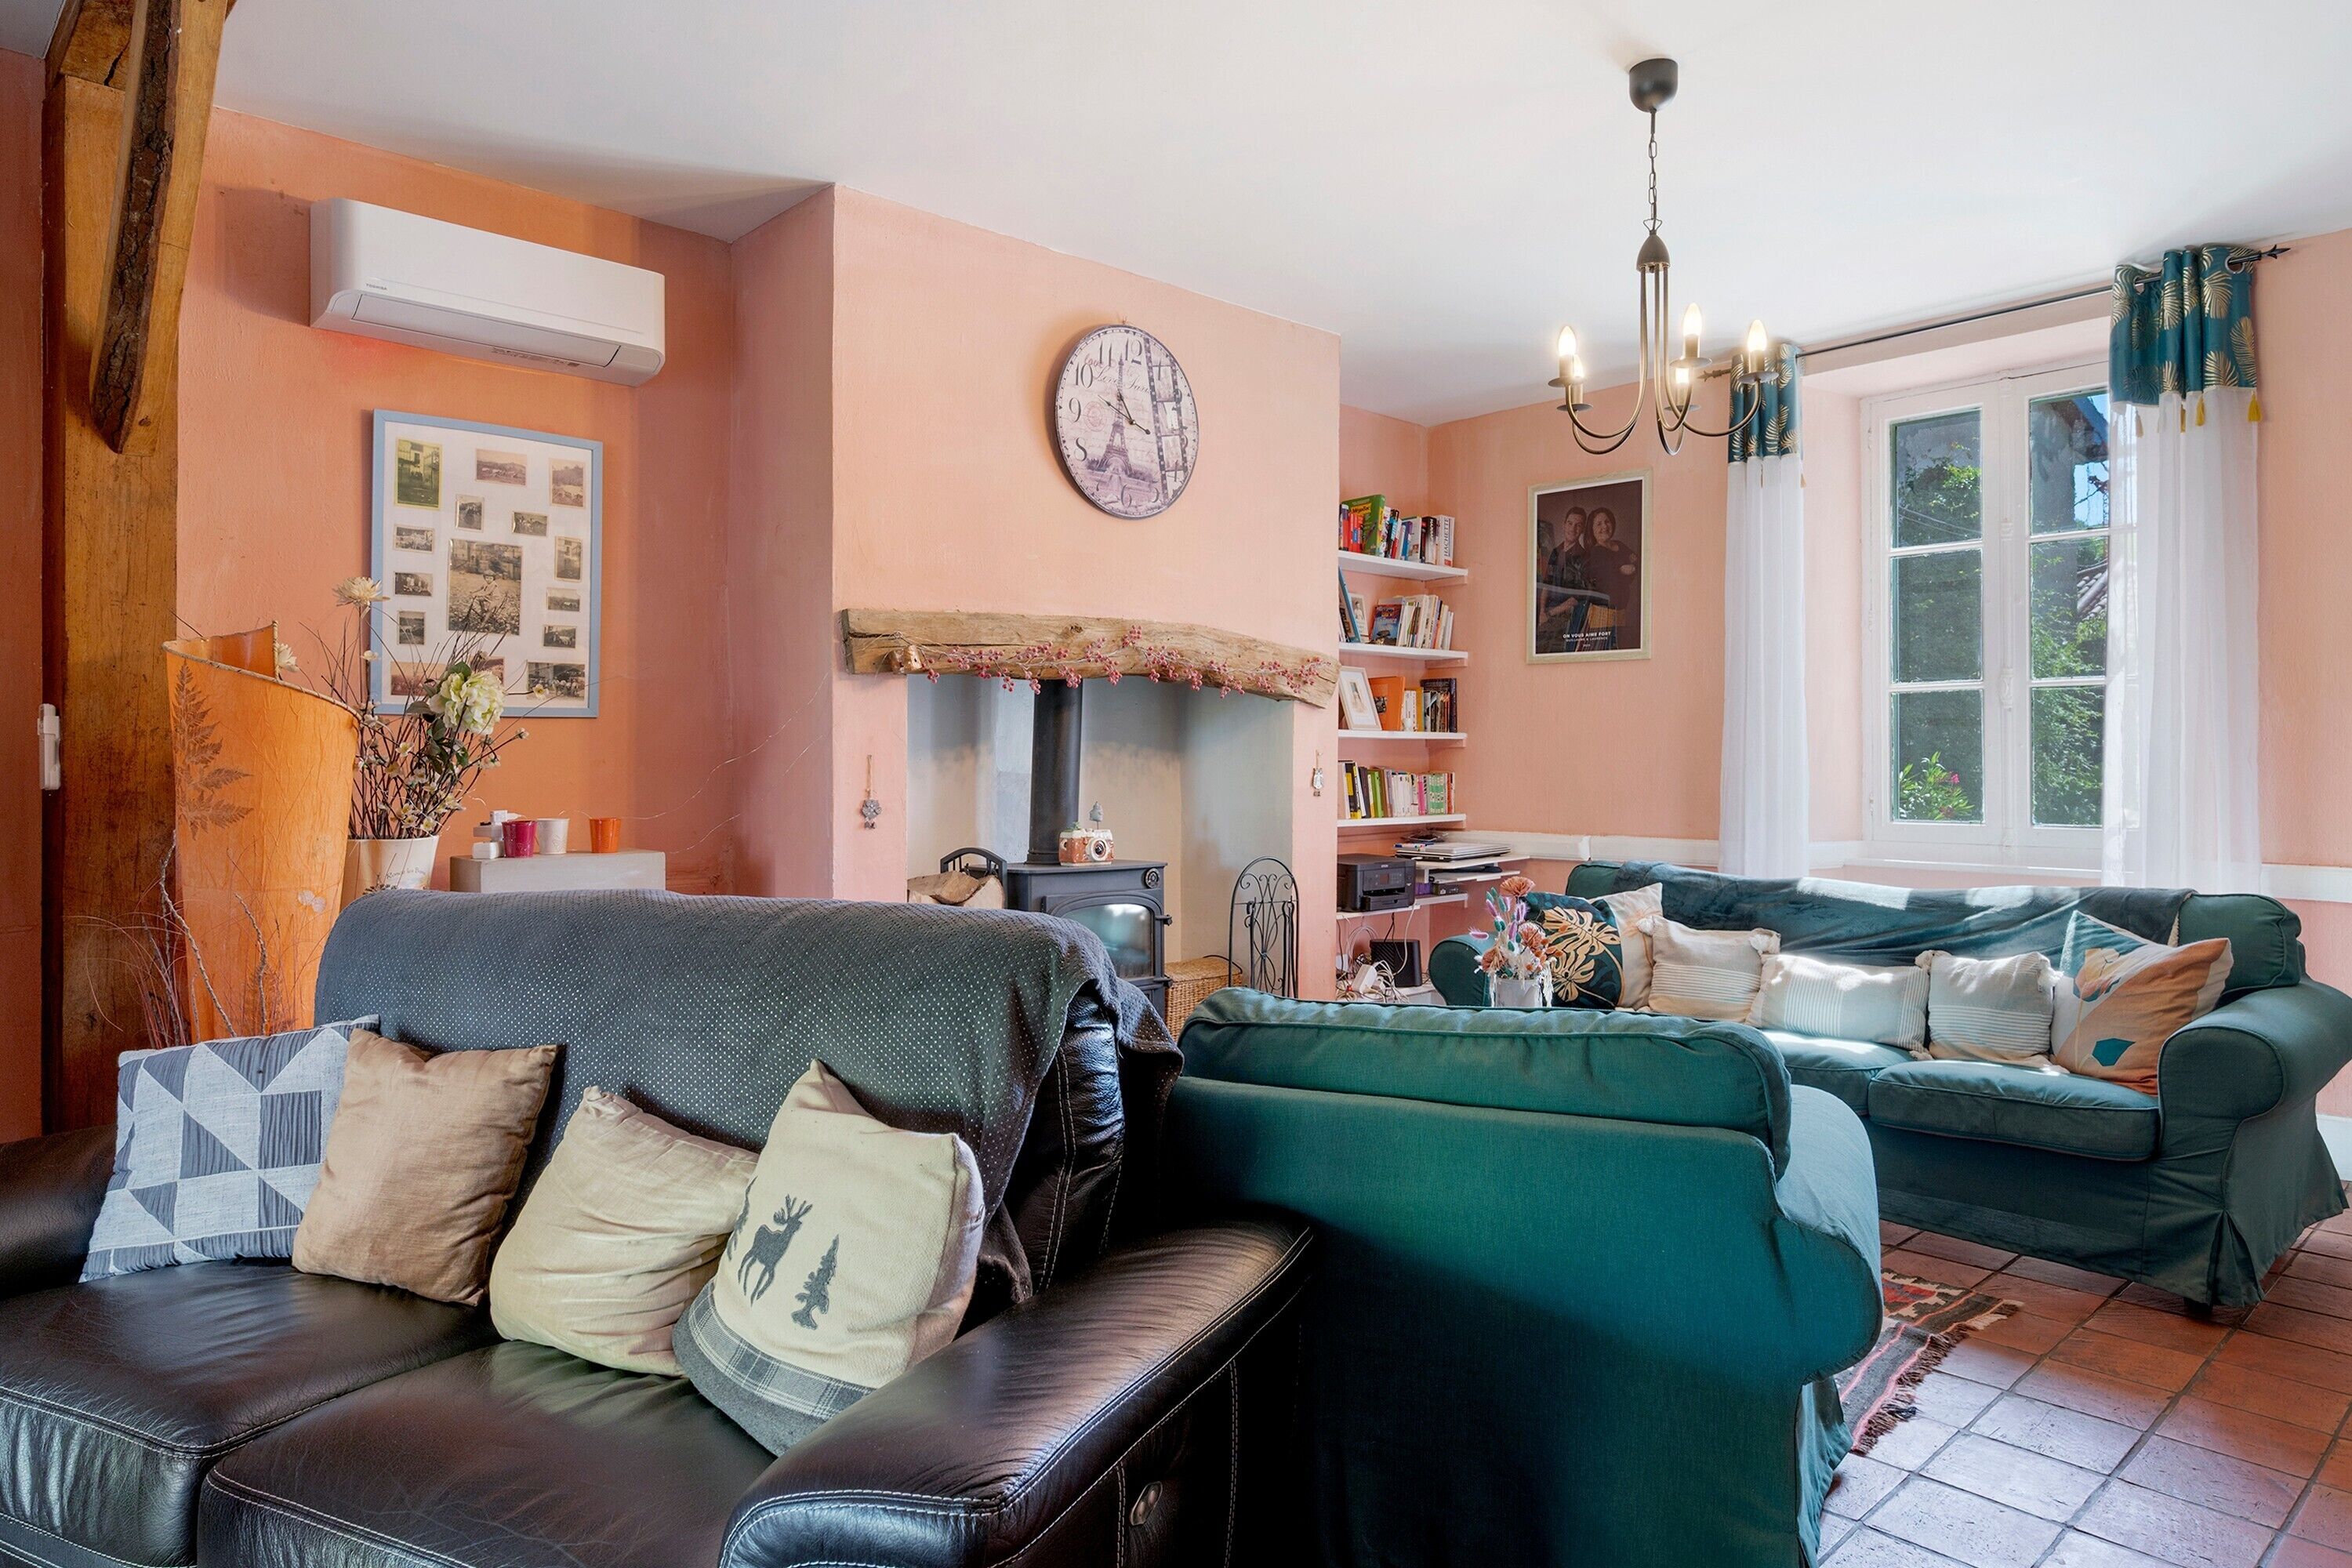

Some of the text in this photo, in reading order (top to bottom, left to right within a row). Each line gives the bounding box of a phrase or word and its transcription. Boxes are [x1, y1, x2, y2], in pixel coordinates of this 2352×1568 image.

[1099, 340, 1112, 367] 11
[1124, 336, 1142, 365] 12
[1075, 361, 1094, 389] 10
[1069, 397, 1081, 423] 9
[1073, 437, 1087, 462] 8
[1120, 484, 1133, 508] 6
